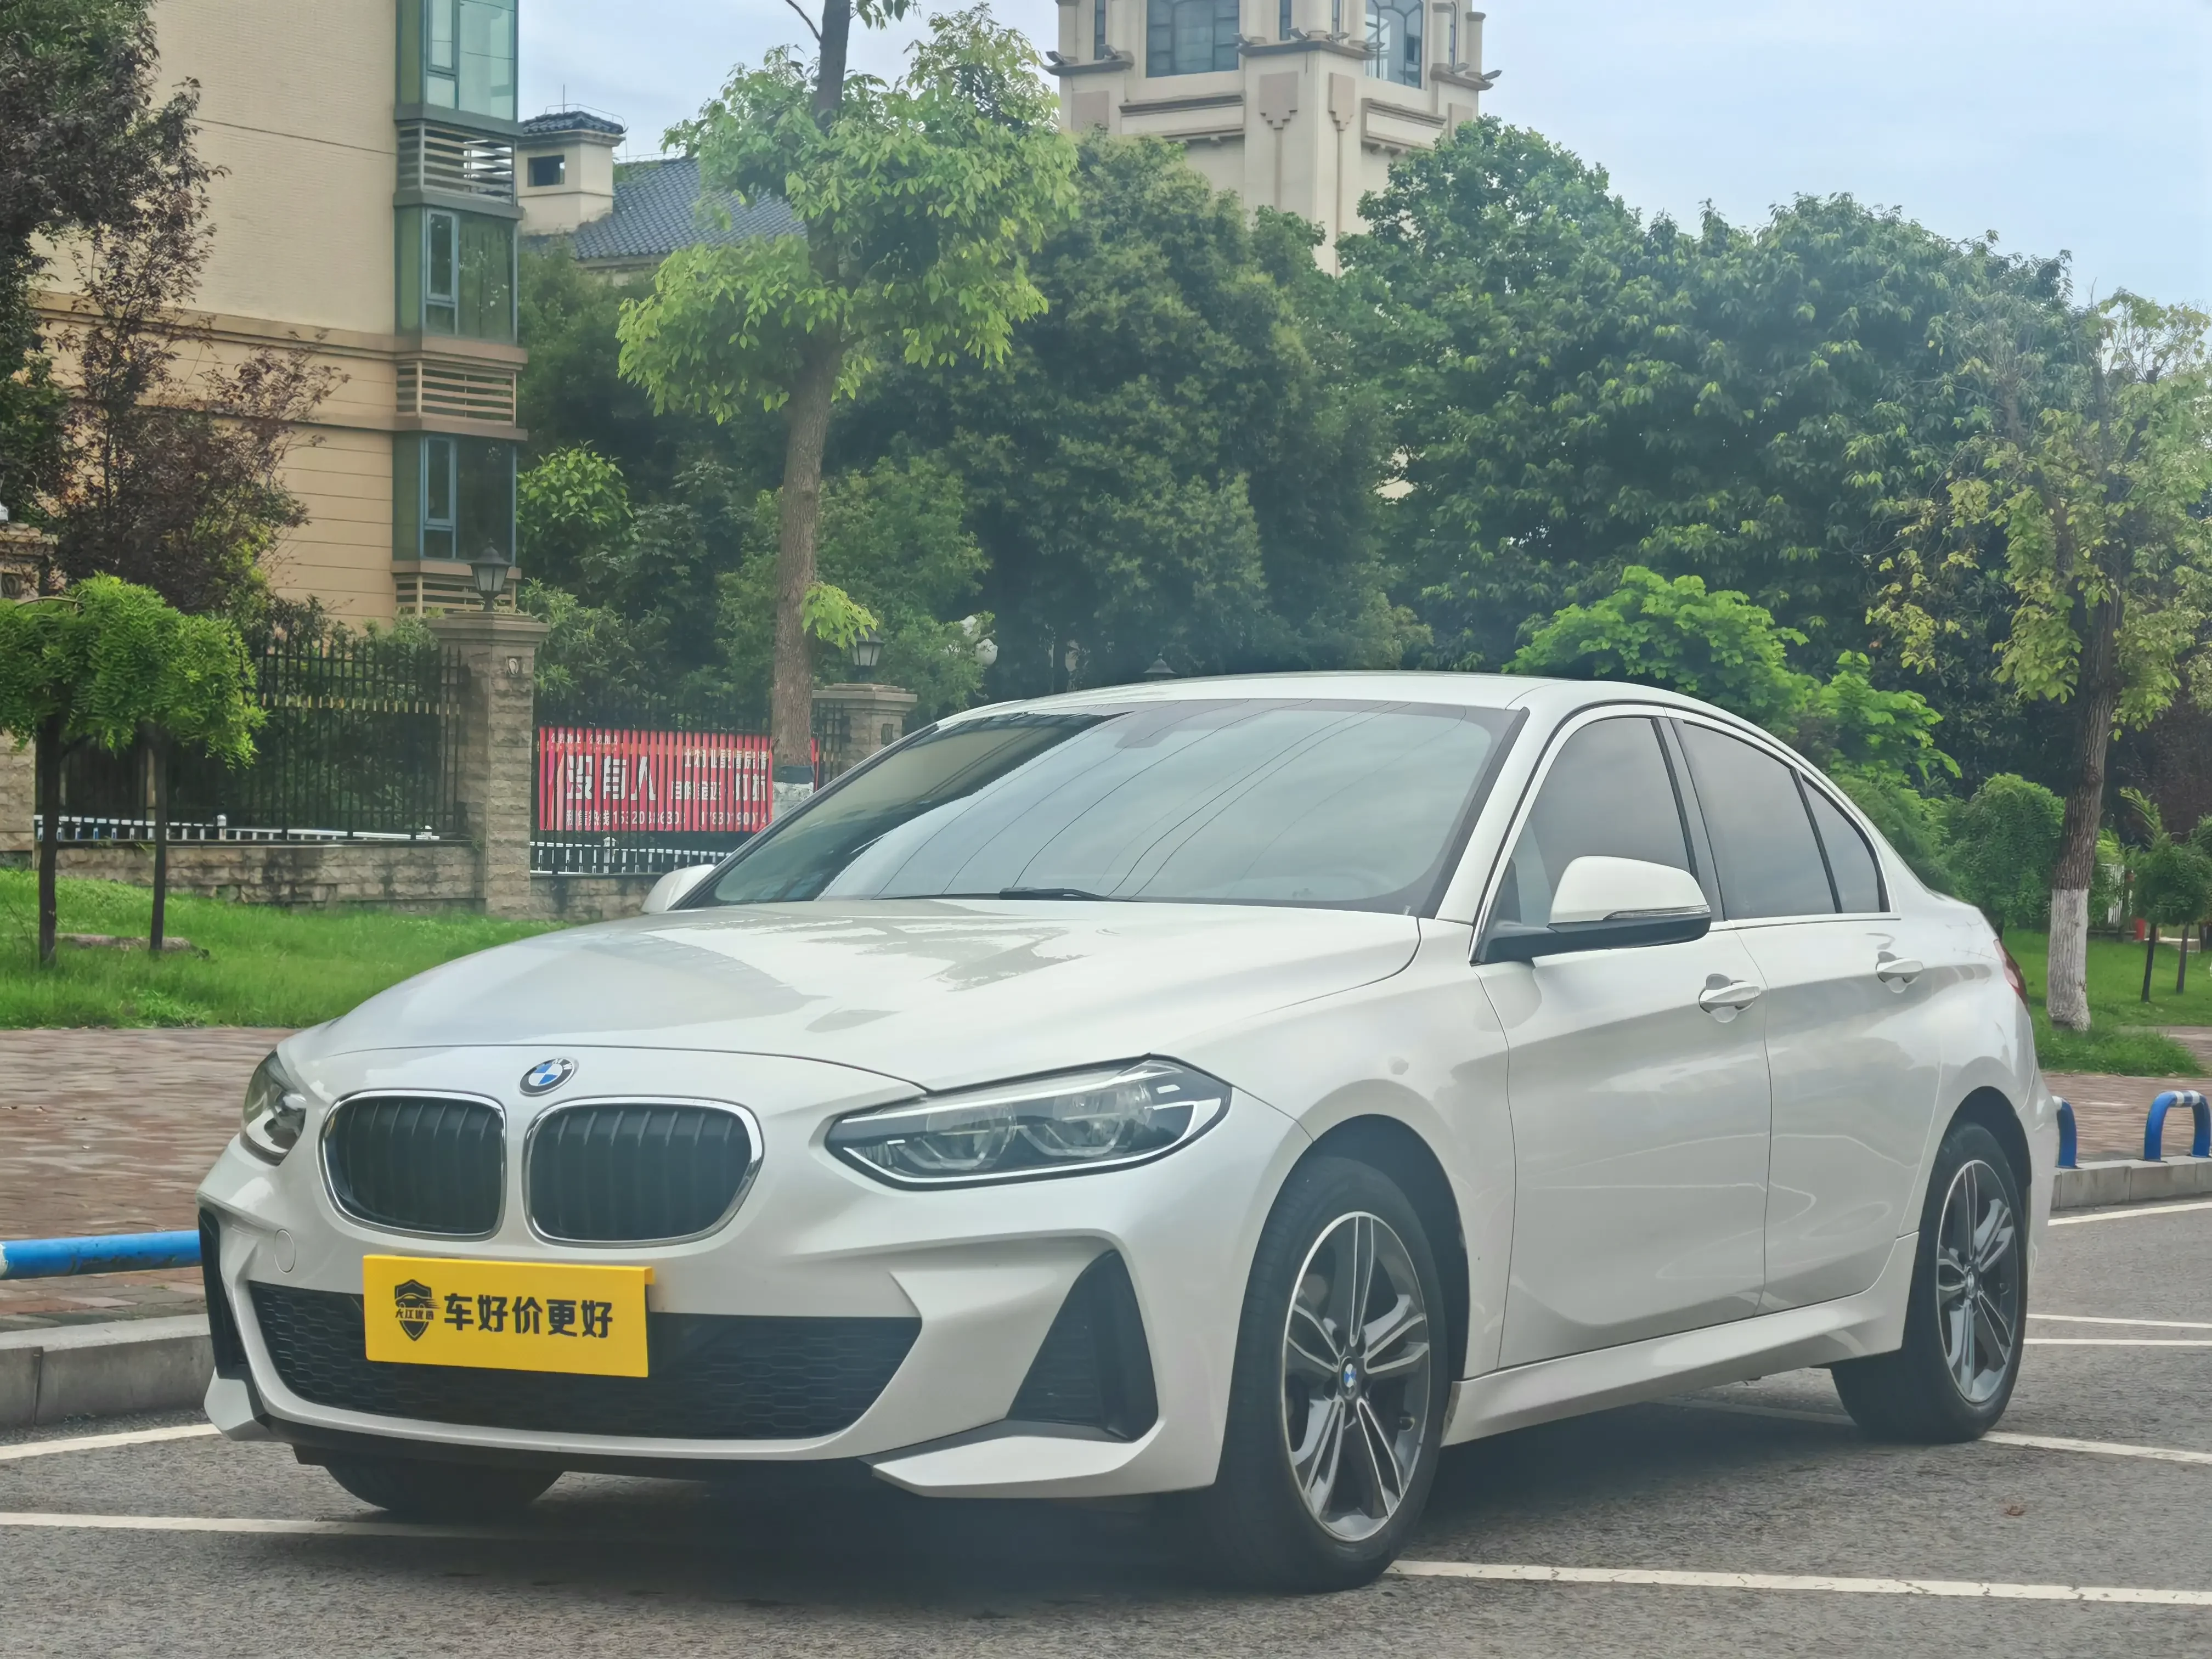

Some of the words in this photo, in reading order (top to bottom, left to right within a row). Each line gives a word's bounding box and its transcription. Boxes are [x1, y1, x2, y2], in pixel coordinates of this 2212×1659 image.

[566, 755, 657, 801] 没有人
[444, 1293, 613, 1339] 车好价更好
